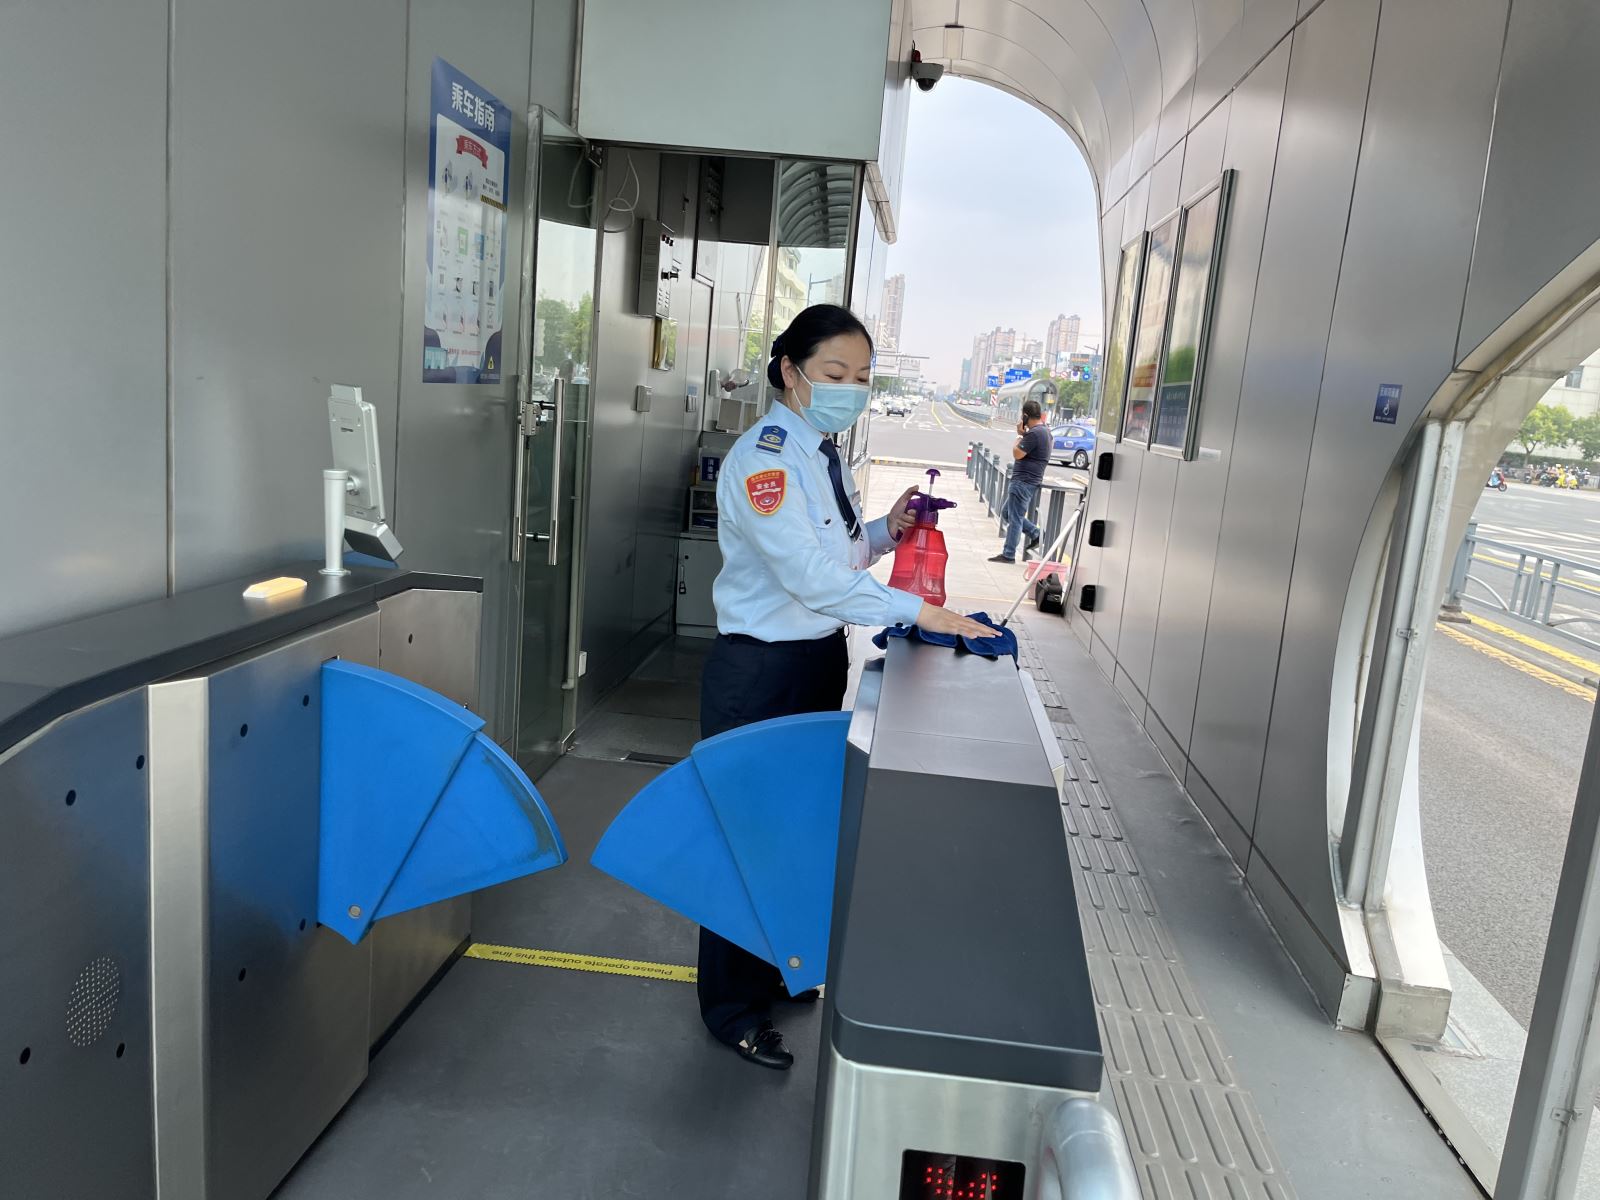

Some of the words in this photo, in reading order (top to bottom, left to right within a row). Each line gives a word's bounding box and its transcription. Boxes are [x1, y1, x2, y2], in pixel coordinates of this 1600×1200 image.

[452, 82, 495, 132] 乘车指南
[756, 481, 776, 490] 安全员
[539, 955, 581, 964] outside
[584, 960, 630, 969] operate
[633, 966, 673, 975] Please
